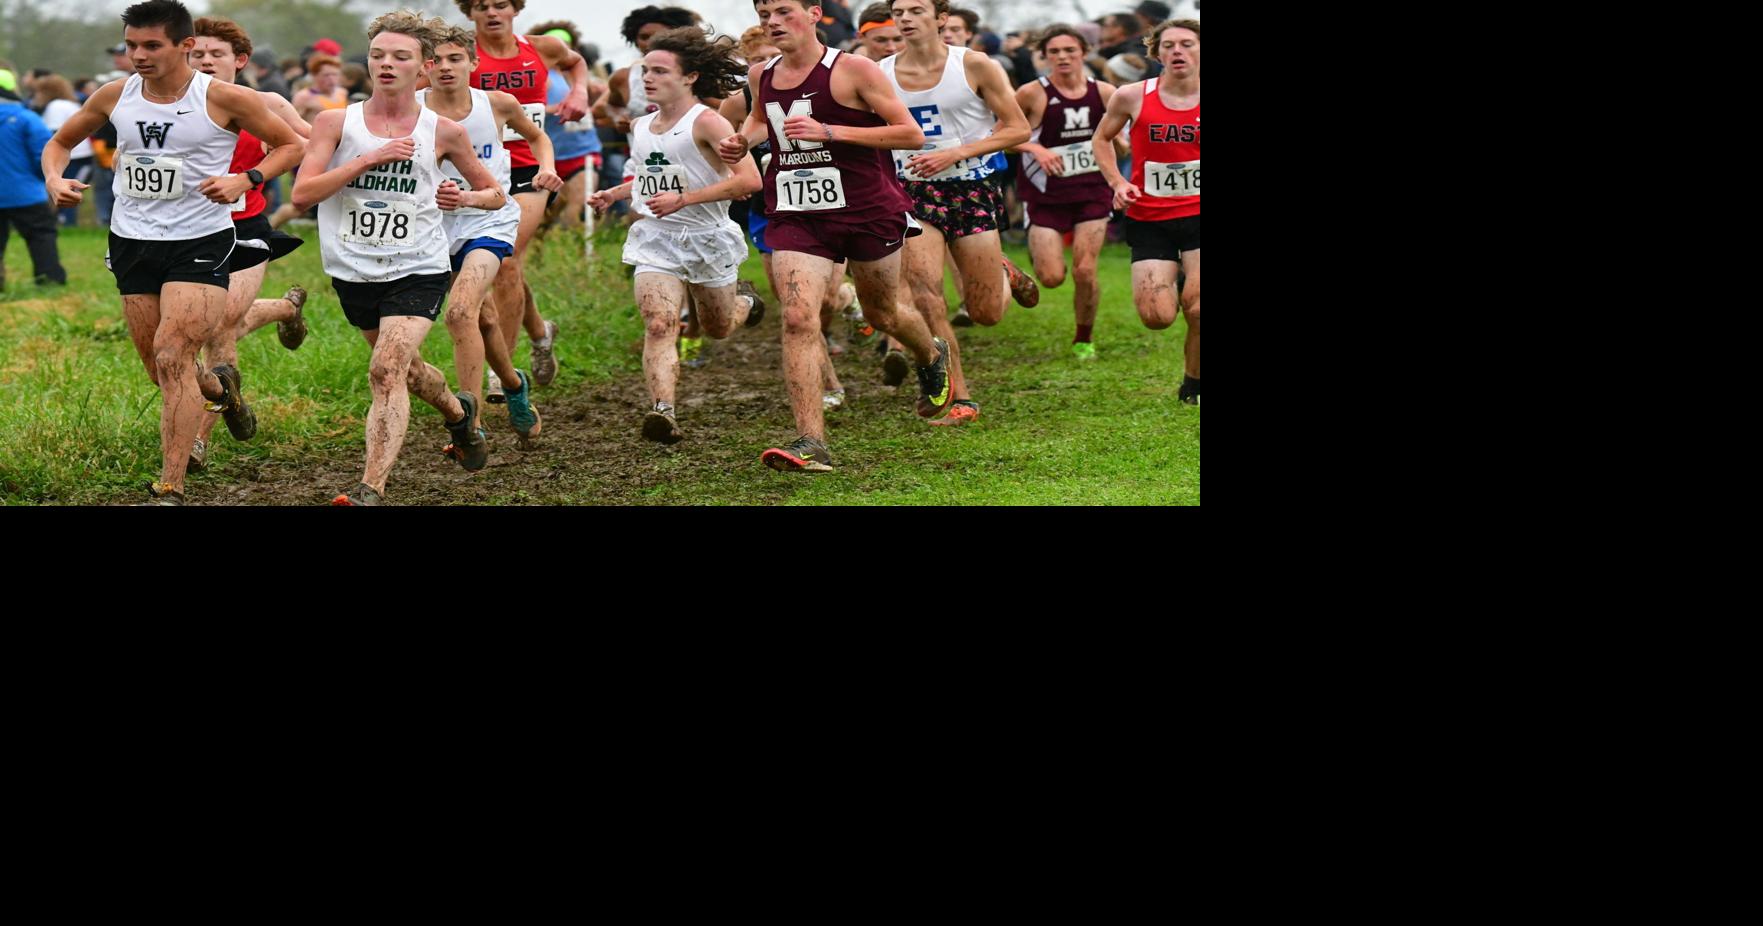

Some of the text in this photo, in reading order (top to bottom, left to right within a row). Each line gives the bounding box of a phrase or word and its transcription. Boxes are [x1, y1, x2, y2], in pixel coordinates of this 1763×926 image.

[480, 70, 537, 91] EAST
[1063, 106, 1091, 129] M
[1149, 124, 1200, 143] EAS
[779, 150, 833, 166] MAROONS
[125, 166, 176, 193] 1997
[638, 174, 684, 196] 2044
[1152, 169, 1200, 191] 1418
[783, 178, 838, 205] 1758
[349, 210, 409, 240] 1978
